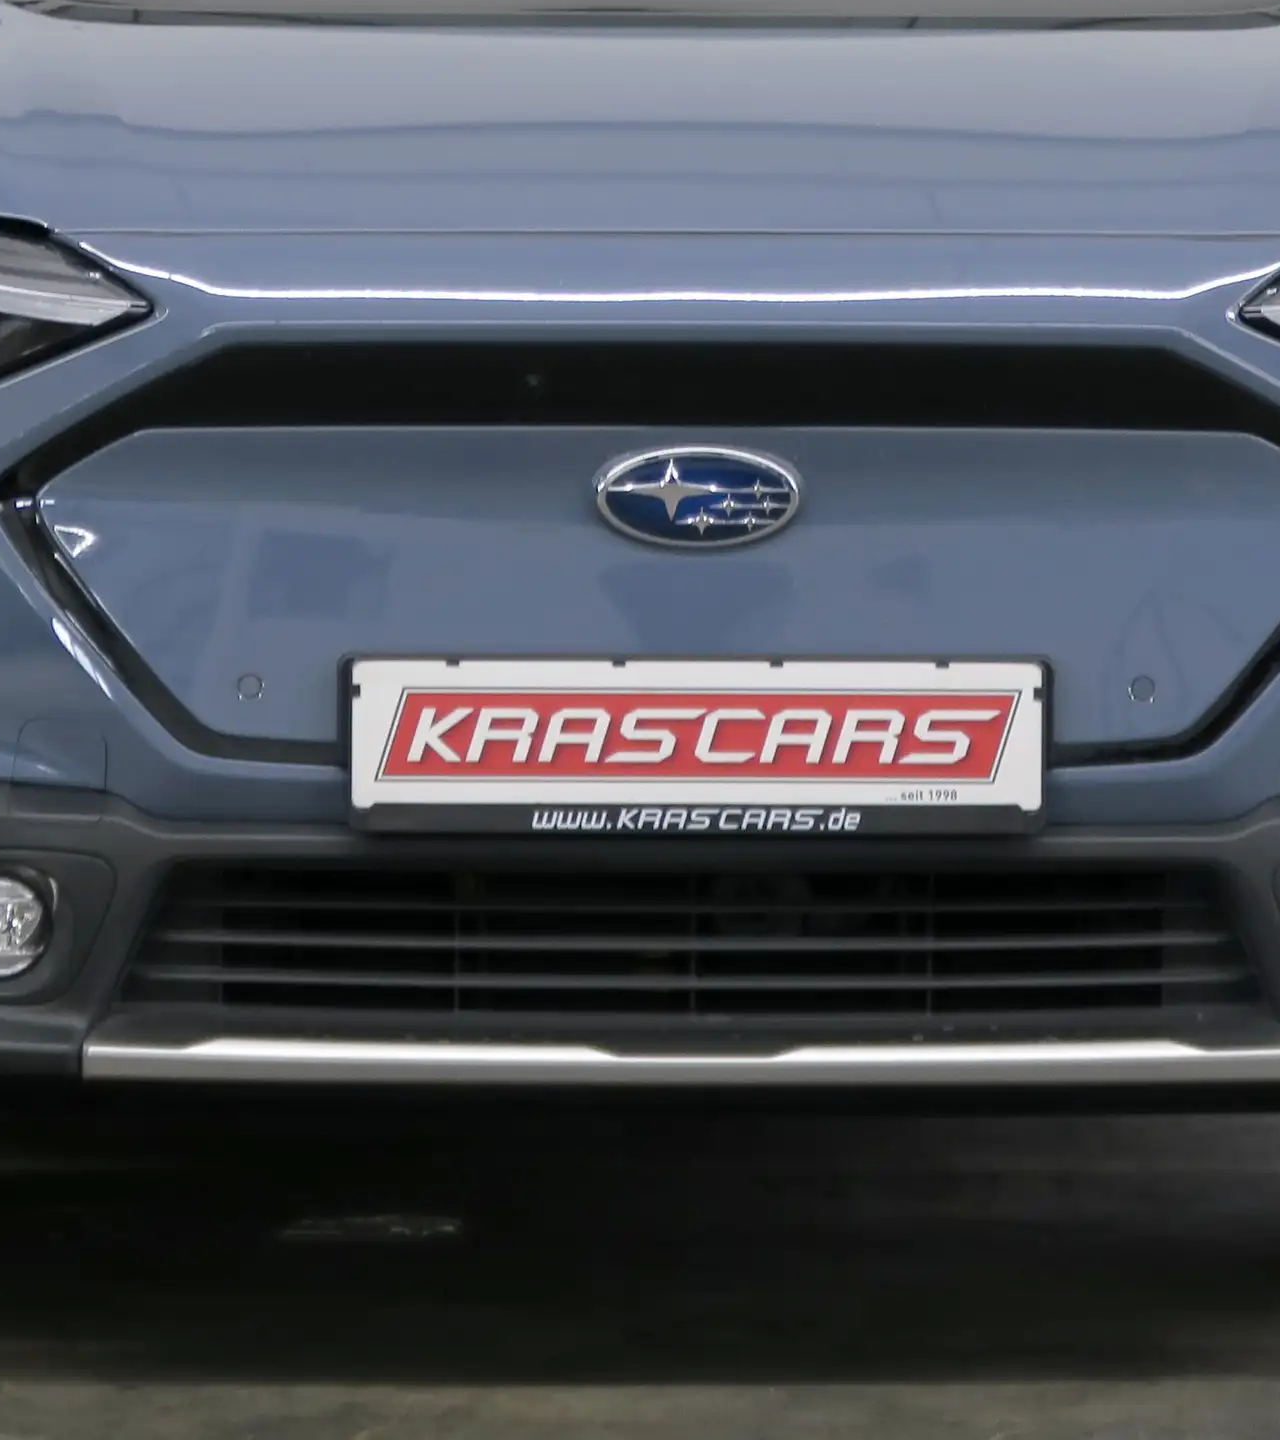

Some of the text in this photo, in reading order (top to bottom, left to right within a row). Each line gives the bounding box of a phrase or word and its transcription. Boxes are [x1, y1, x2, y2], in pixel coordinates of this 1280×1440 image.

[408, 707, 1001, 764] KRASCARS
[901, 789, 923, 801] seit
[928, 789, 957, 802] 1998
[531, 807, 862, 832] www.KRASCARS.de
